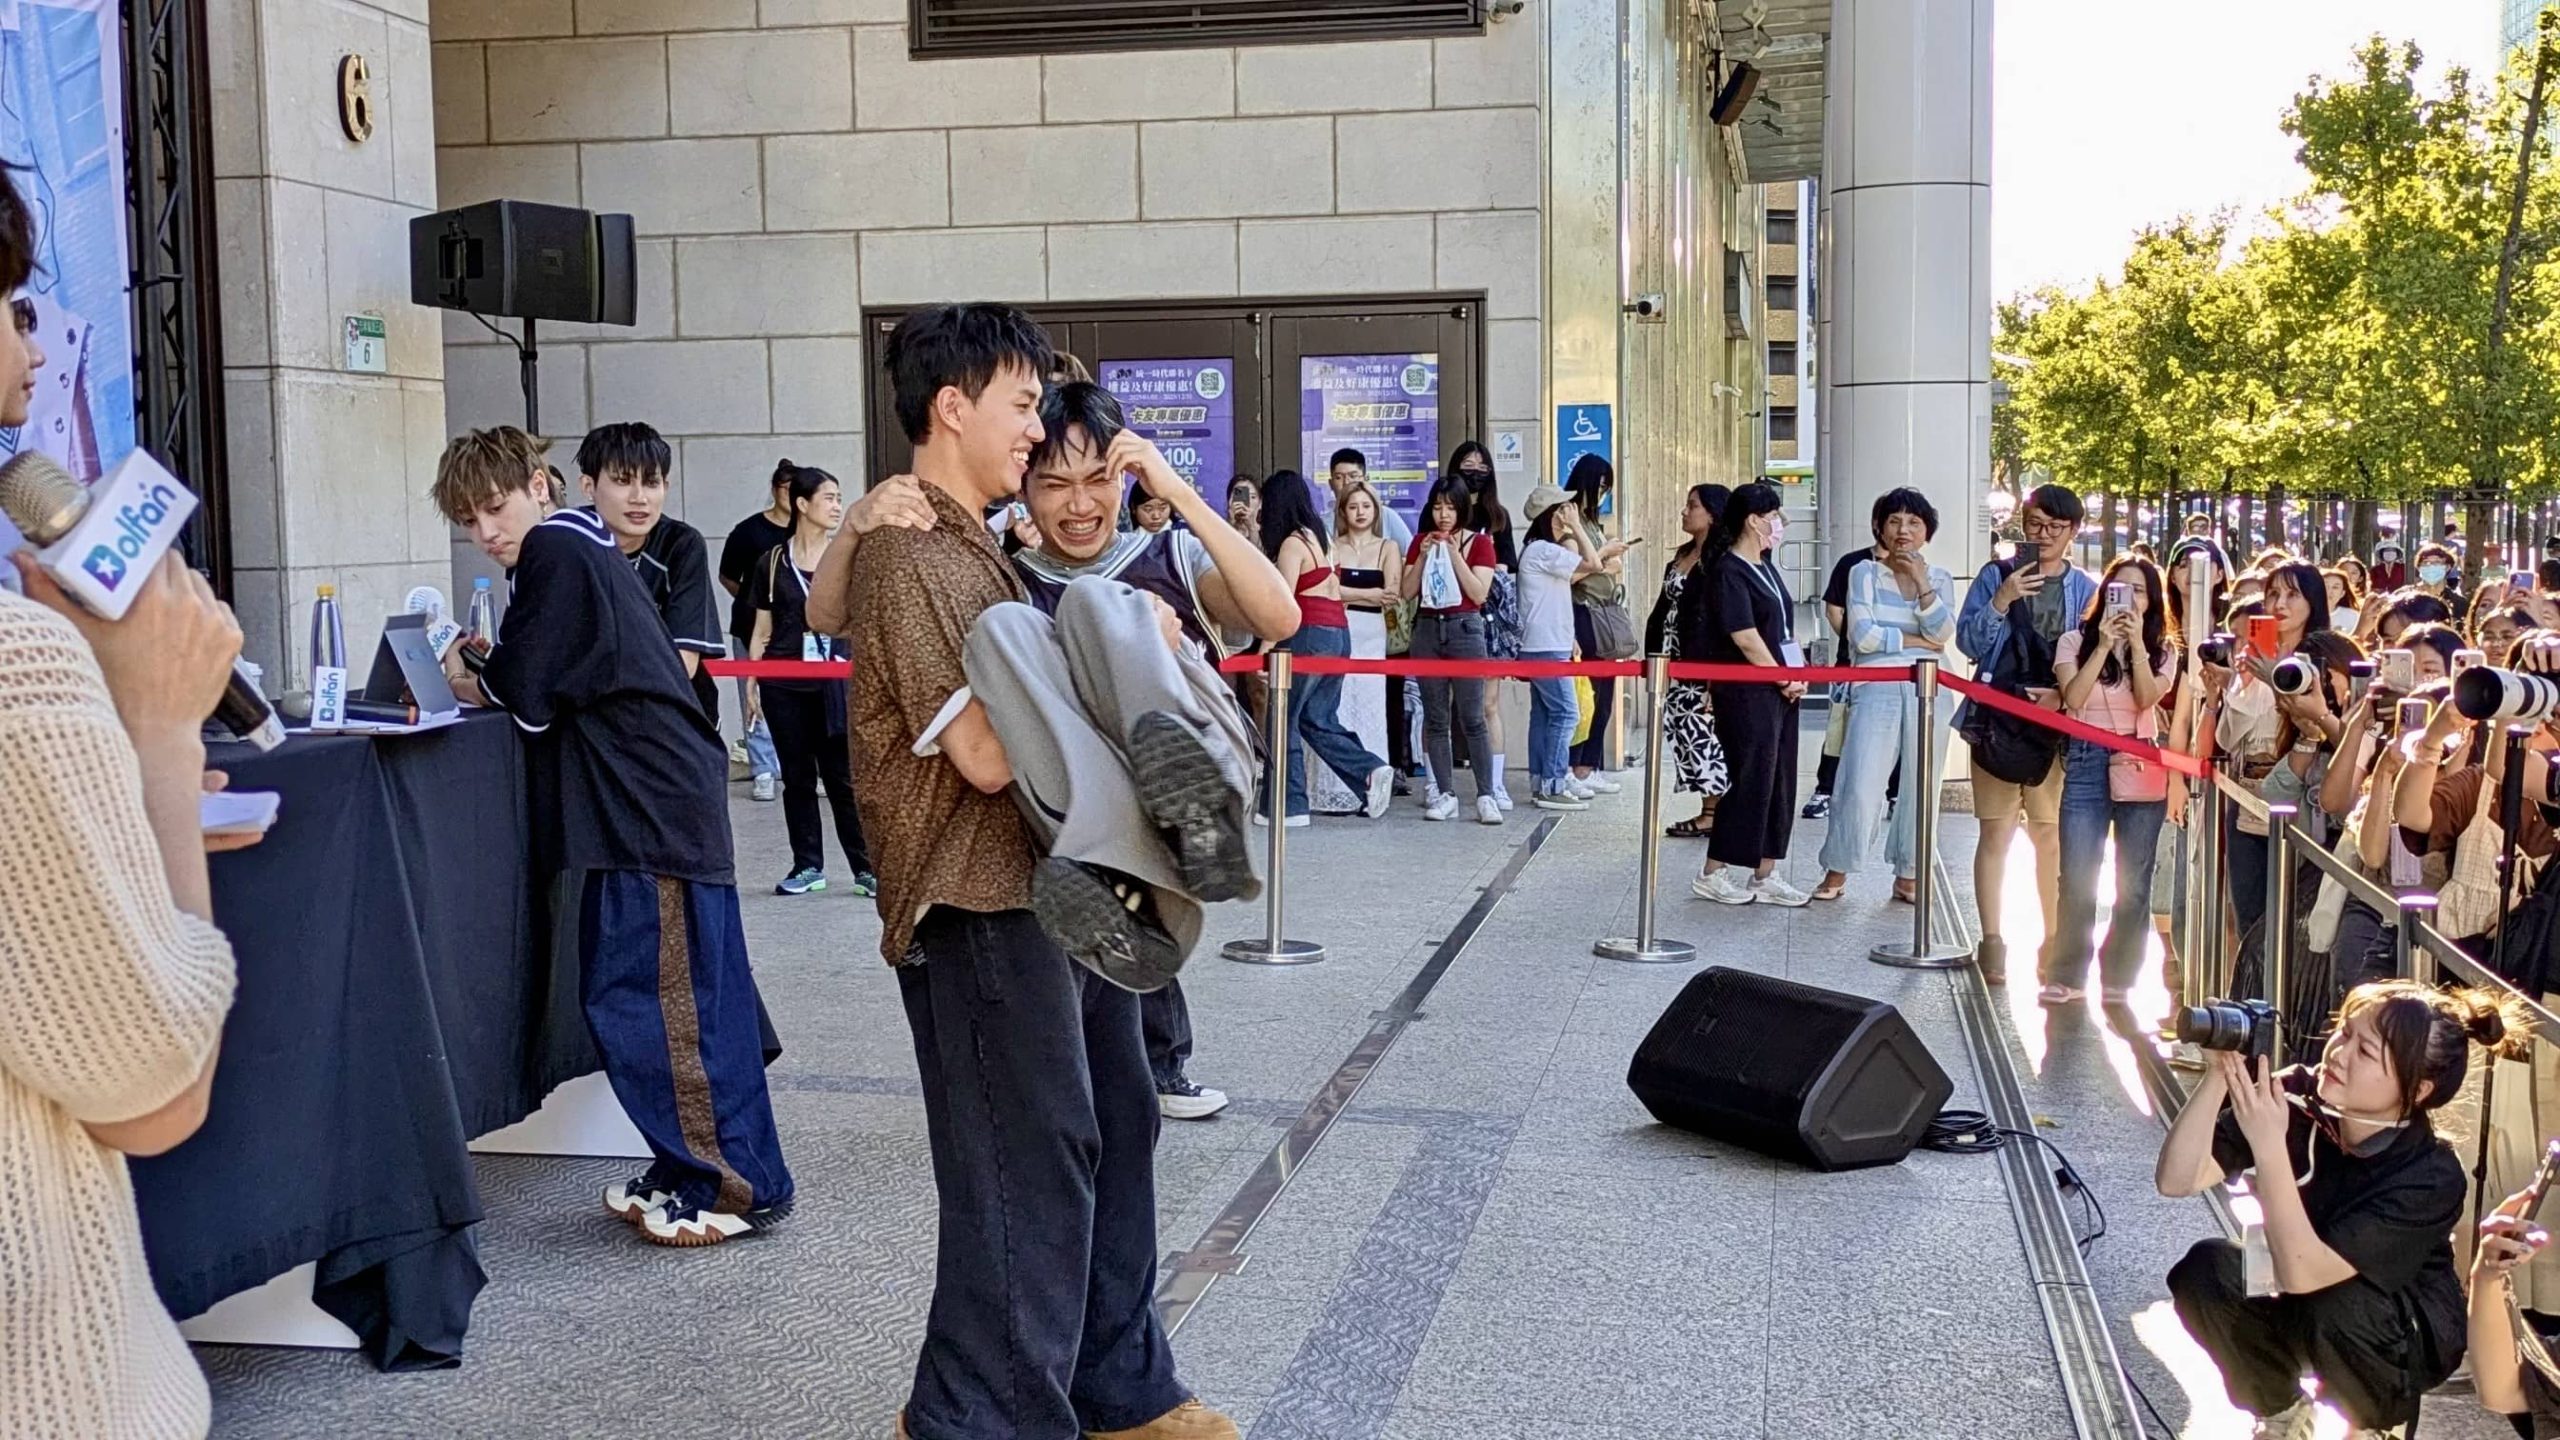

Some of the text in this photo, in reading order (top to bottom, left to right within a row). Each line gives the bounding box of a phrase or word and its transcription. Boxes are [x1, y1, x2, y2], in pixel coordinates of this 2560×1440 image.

[337, 54, 372, 142] 6
[364, 342, 371, 364] 6
[1131, 407, 1206, 424] 卡友專屬優惠
[1331, 403, 1409, 420] 卡友專屬優惠
